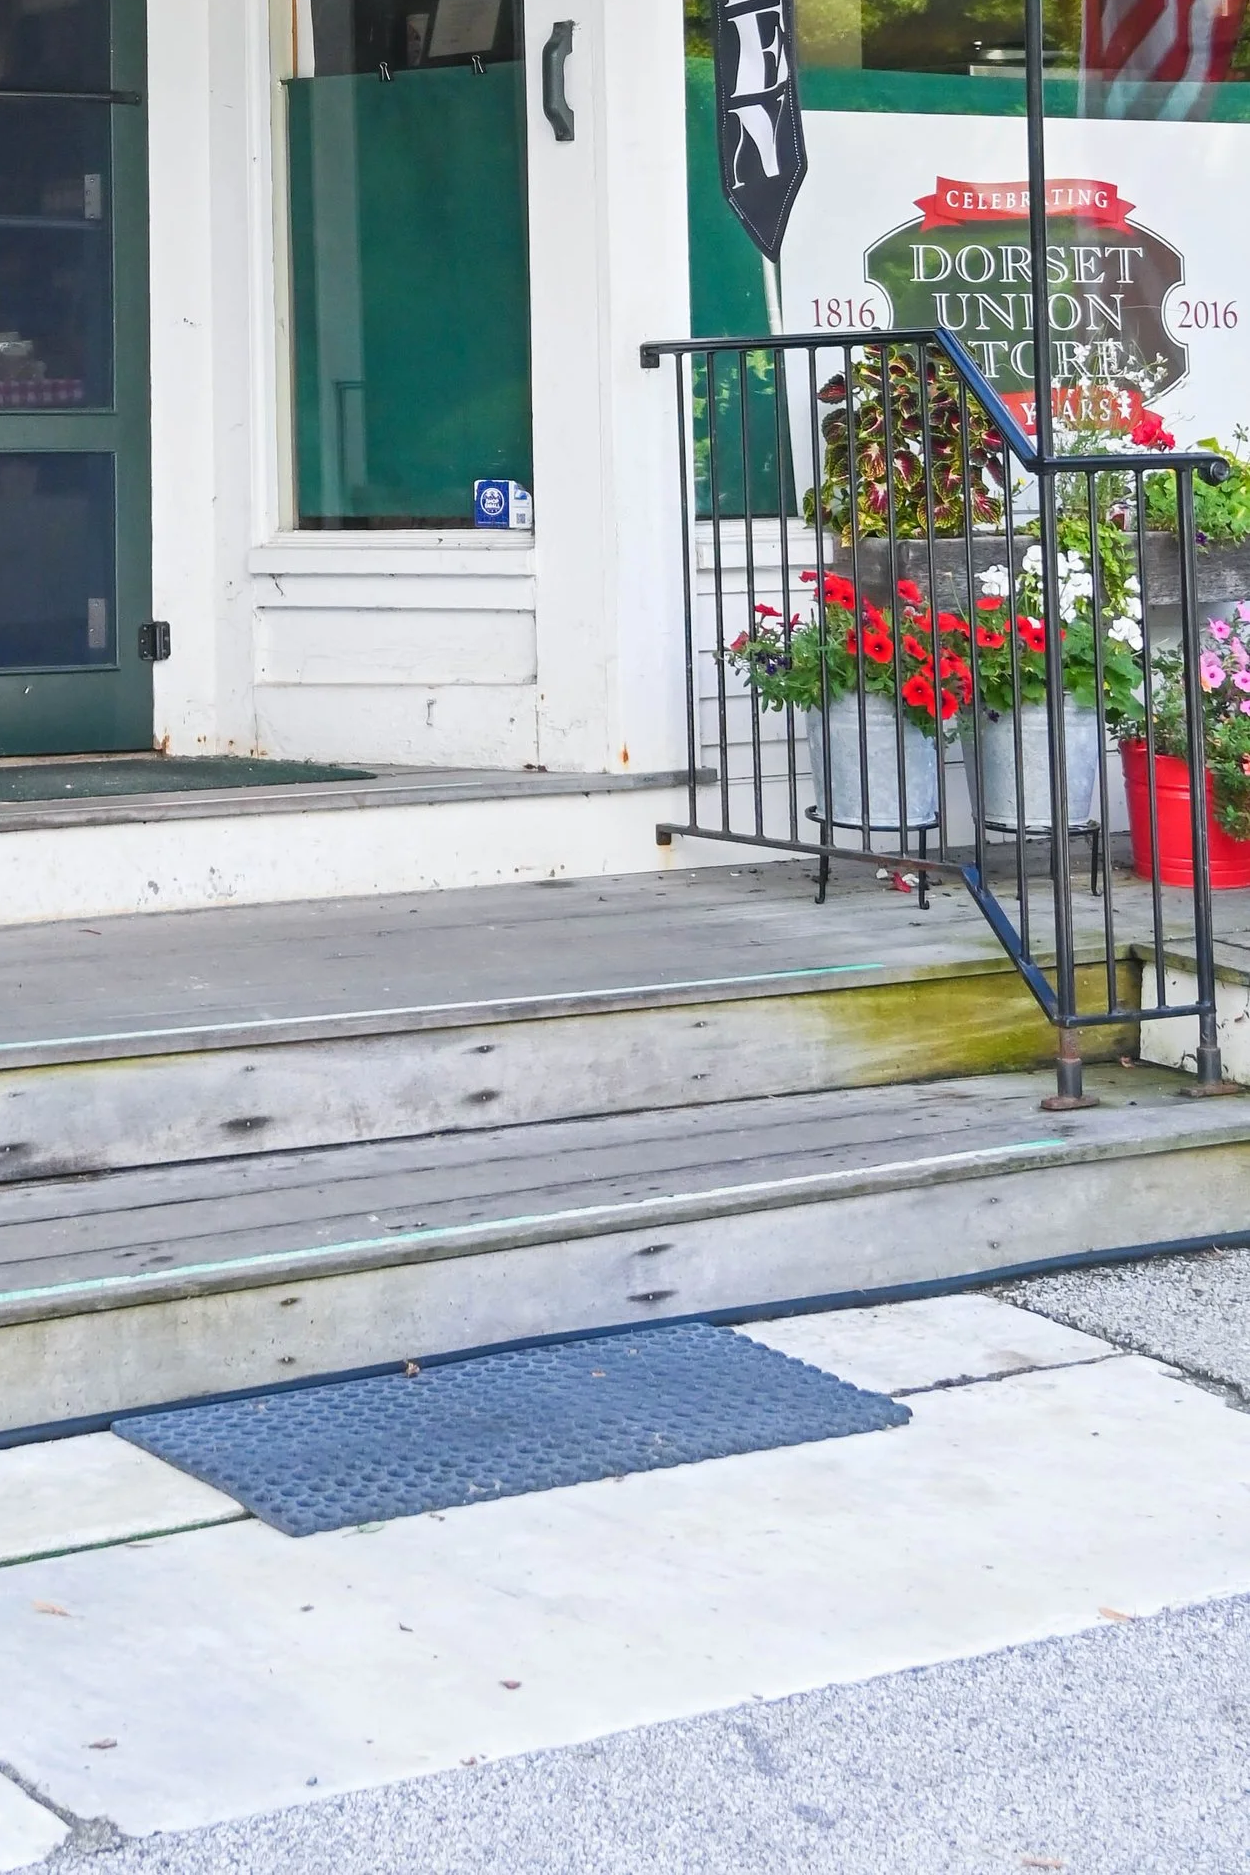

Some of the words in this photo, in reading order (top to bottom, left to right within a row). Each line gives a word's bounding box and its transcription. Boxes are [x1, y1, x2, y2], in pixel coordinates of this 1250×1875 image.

[945, 189, 1109, 211] CELEBRTING
[908, 243, 1144, 285] DORSET
[811, 298, 876, 328] 1816
[1177, 300, 1238, 329] 2016
[966, 339, 1128, 379] TORE
[1019, 398, 1112, 426] YARS
